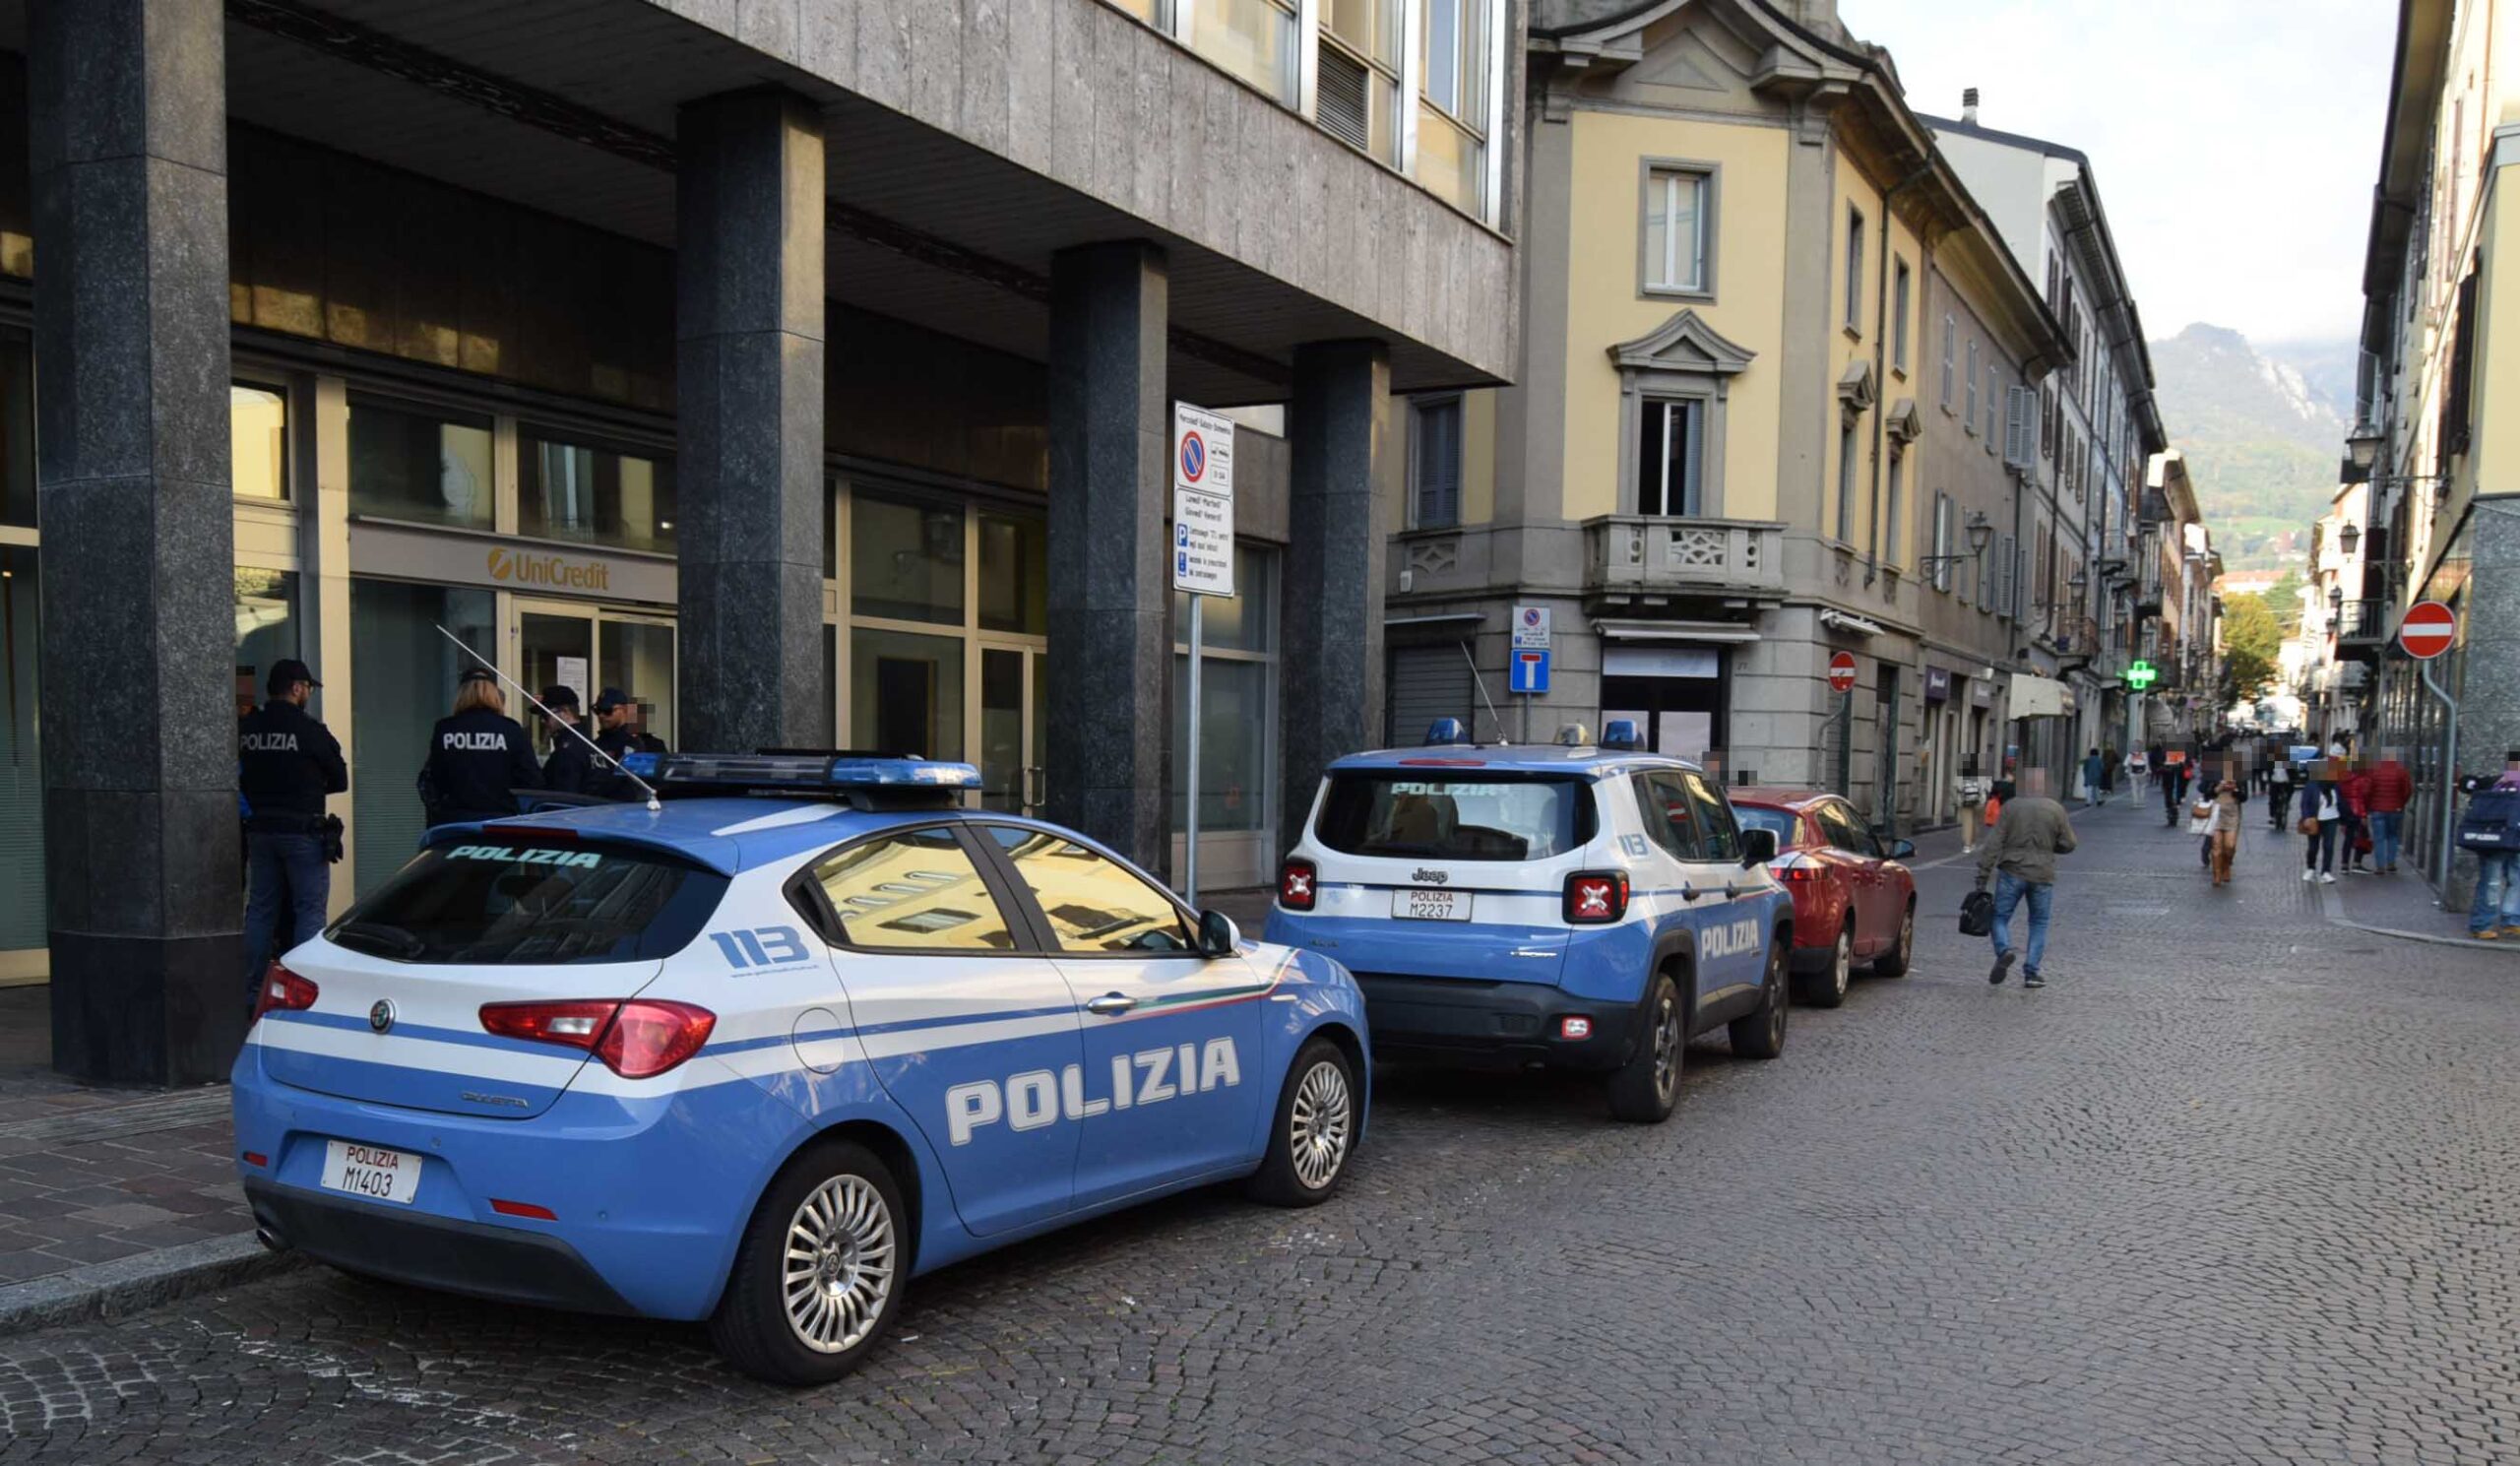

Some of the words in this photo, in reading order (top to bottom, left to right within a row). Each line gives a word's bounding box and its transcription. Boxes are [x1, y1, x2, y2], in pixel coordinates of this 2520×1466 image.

[515, 551, 609, 591] UniCredit
[239, 733, 299, 752] POLIZIA
[442, 732, 508, 751] POLIZIA
[1390, 782, 1497, 797] POLIZIA
[445, 845, 602, 869] POLIZIA
[1412, 866, 1449, 885] Jeep
[1410, 890, 1454, 903] POLIZIA
[1410, 902, 1454, 919] M2237
[708, 925, 811, 970] 113
[1701, 918, 1759, 961] POLIZIA
[945, 1036, 1241, 1147] POLIZIA
[346, 1146, 399, 1170] POLIZIA
[342, 1166, 394, 1197] M1403
